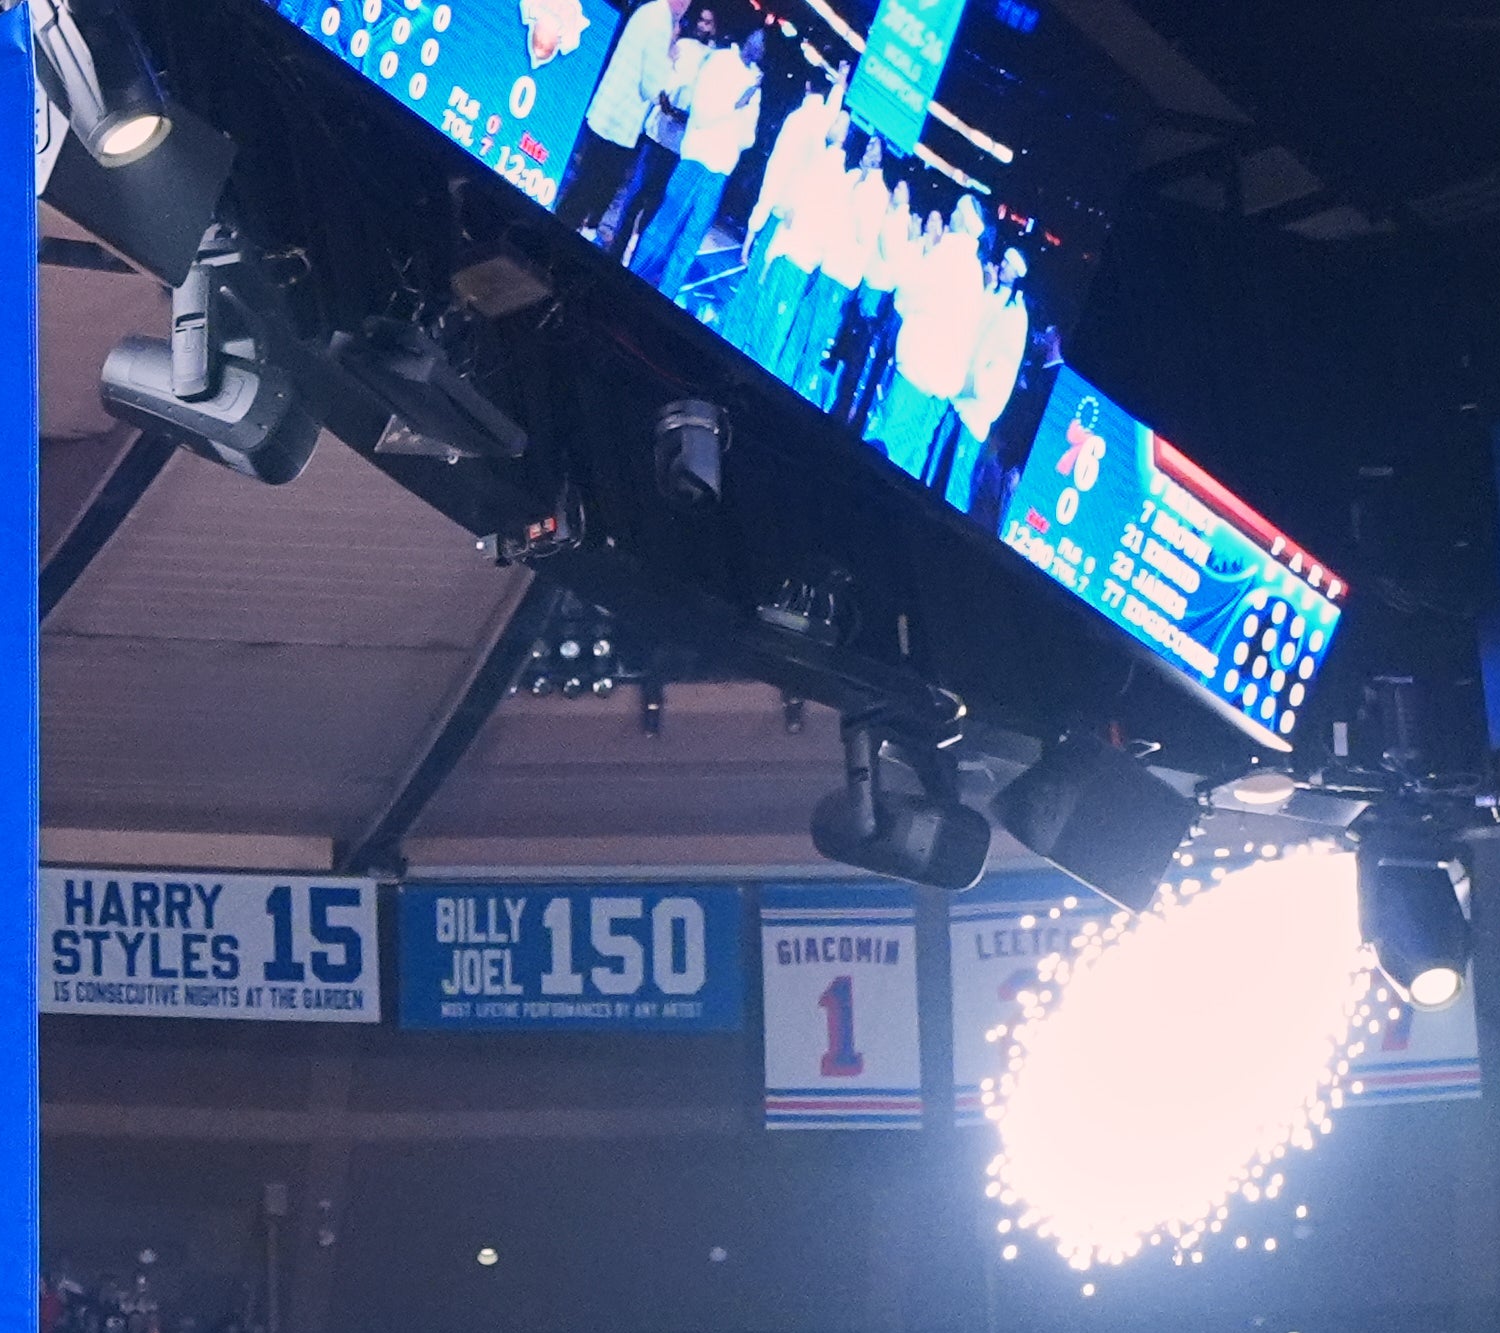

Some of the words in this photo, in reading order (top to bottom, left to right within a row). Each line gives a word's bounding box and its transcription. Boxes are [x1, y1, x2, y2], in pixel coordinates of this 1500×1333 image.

[508, 76, 536, 119] 0
[494, 147, 556, 206] 12:00
[1056, 487, 1079, 525] 0
[64, 879, 223, 929] HARRY
[435, 897, 527, 944] BILLY
[52, 929, 240, 980] STYLES
[263, 885, 363, 984] 15
[541, 897, 707, 995] 150
[76, 981, 181, 1006] CONSECUTIVE
[184, 984, 239, 1008] NIGHTS
[246, 987, 264, 1008] AT
[270, 987, 297, 1009] THE
[303, 988, 365, 1010] GARDEN
[441, 949, 524, 995] JOEL
[817, 974, 865, 1079] 1
